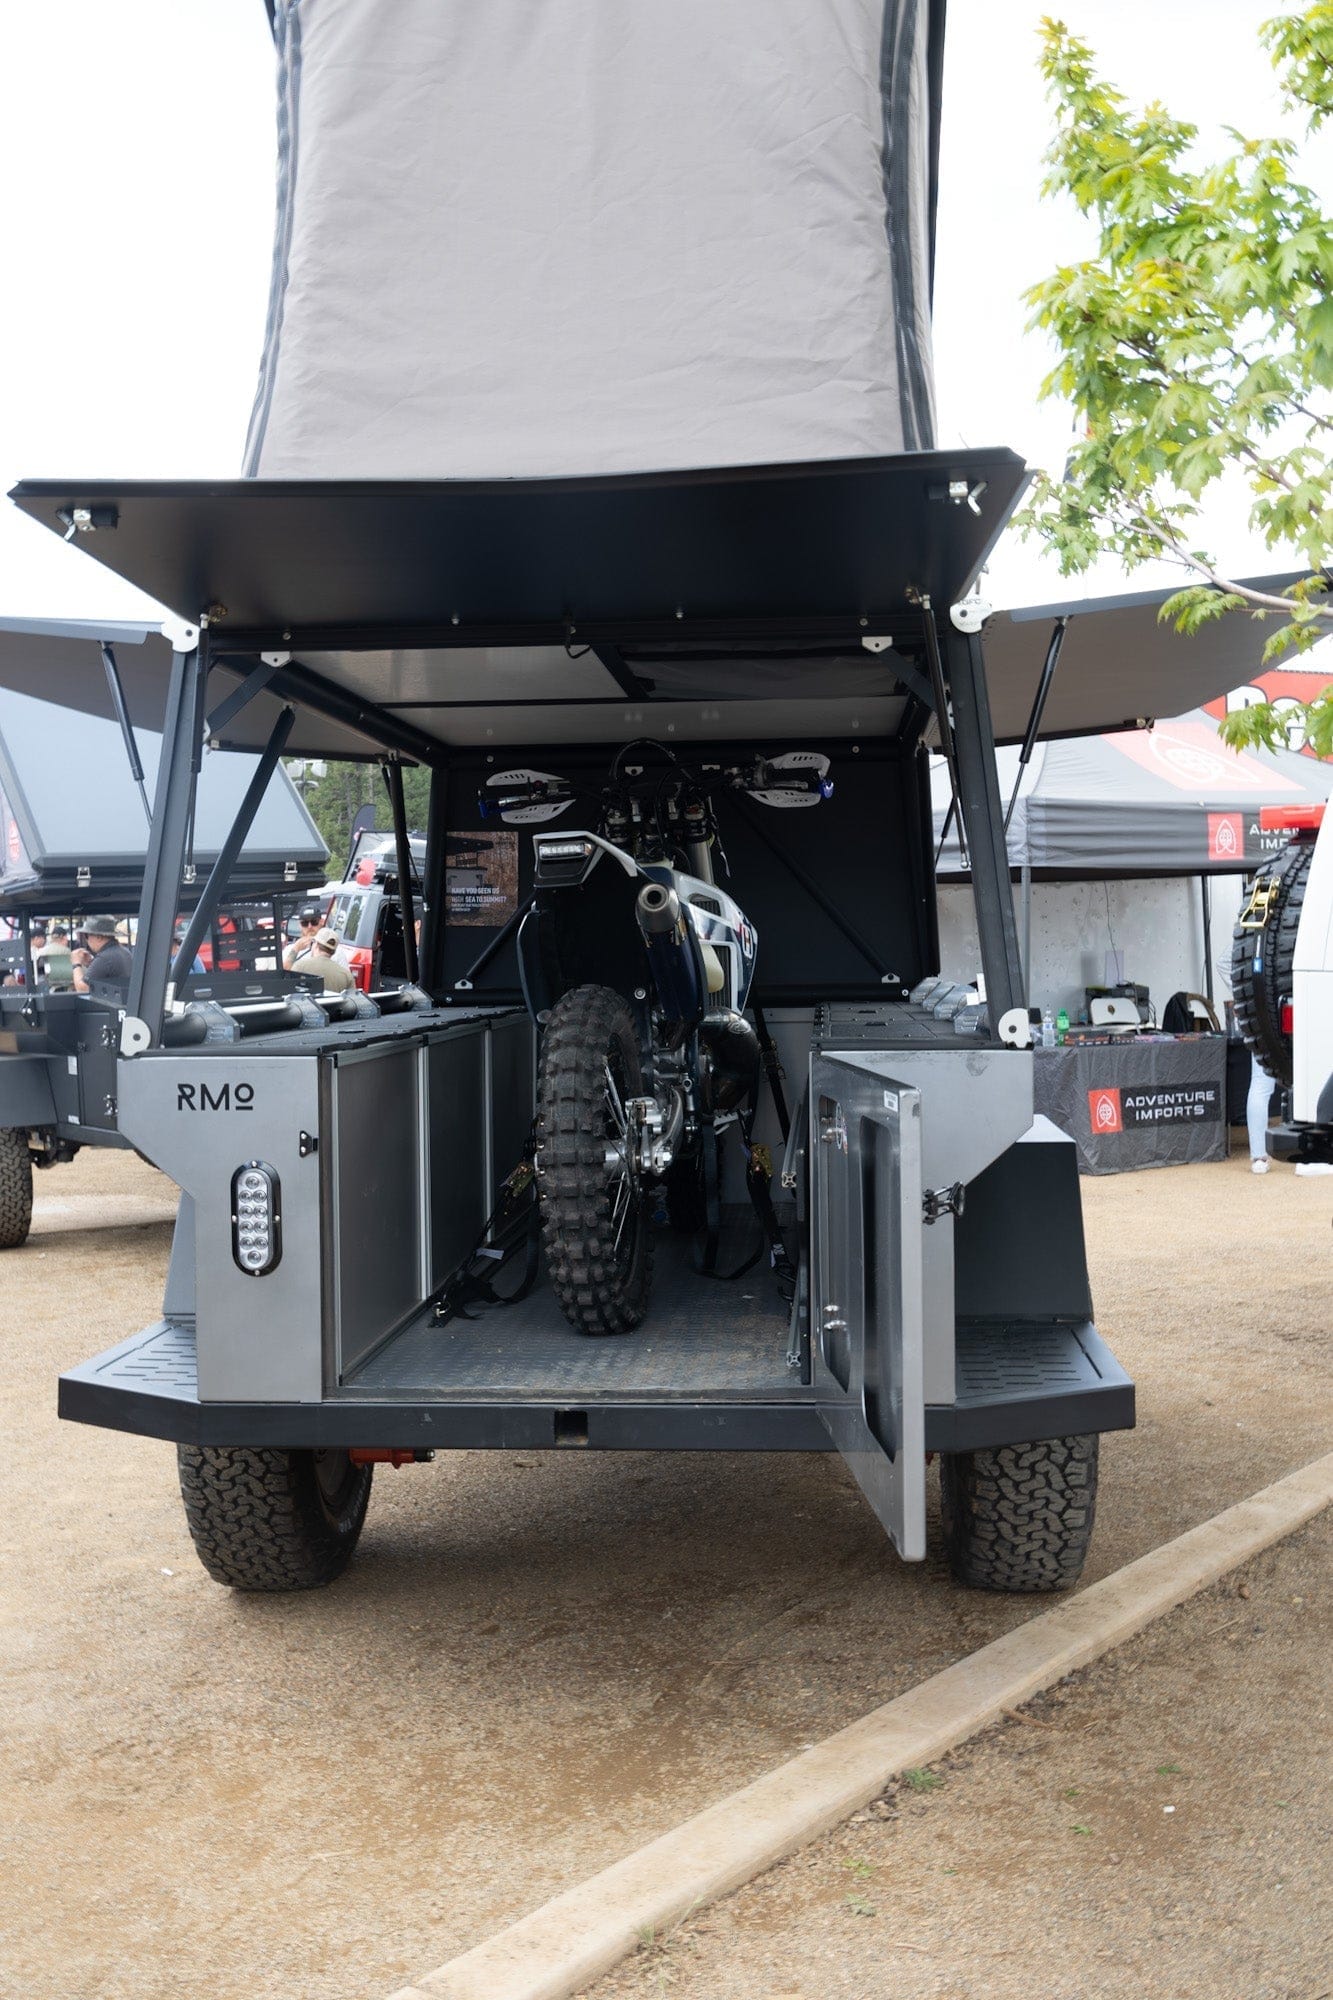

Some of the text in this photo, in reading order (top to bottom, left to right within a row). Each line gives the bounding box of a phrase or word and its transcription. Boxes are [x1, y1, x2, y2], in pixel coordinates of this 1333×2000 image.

[177, 1082, 255, 1112] RMO
[1125, 1090, 1215, 1108] ADVENTURE
[1135, 1104, 1205, 1121] IMPORTS
